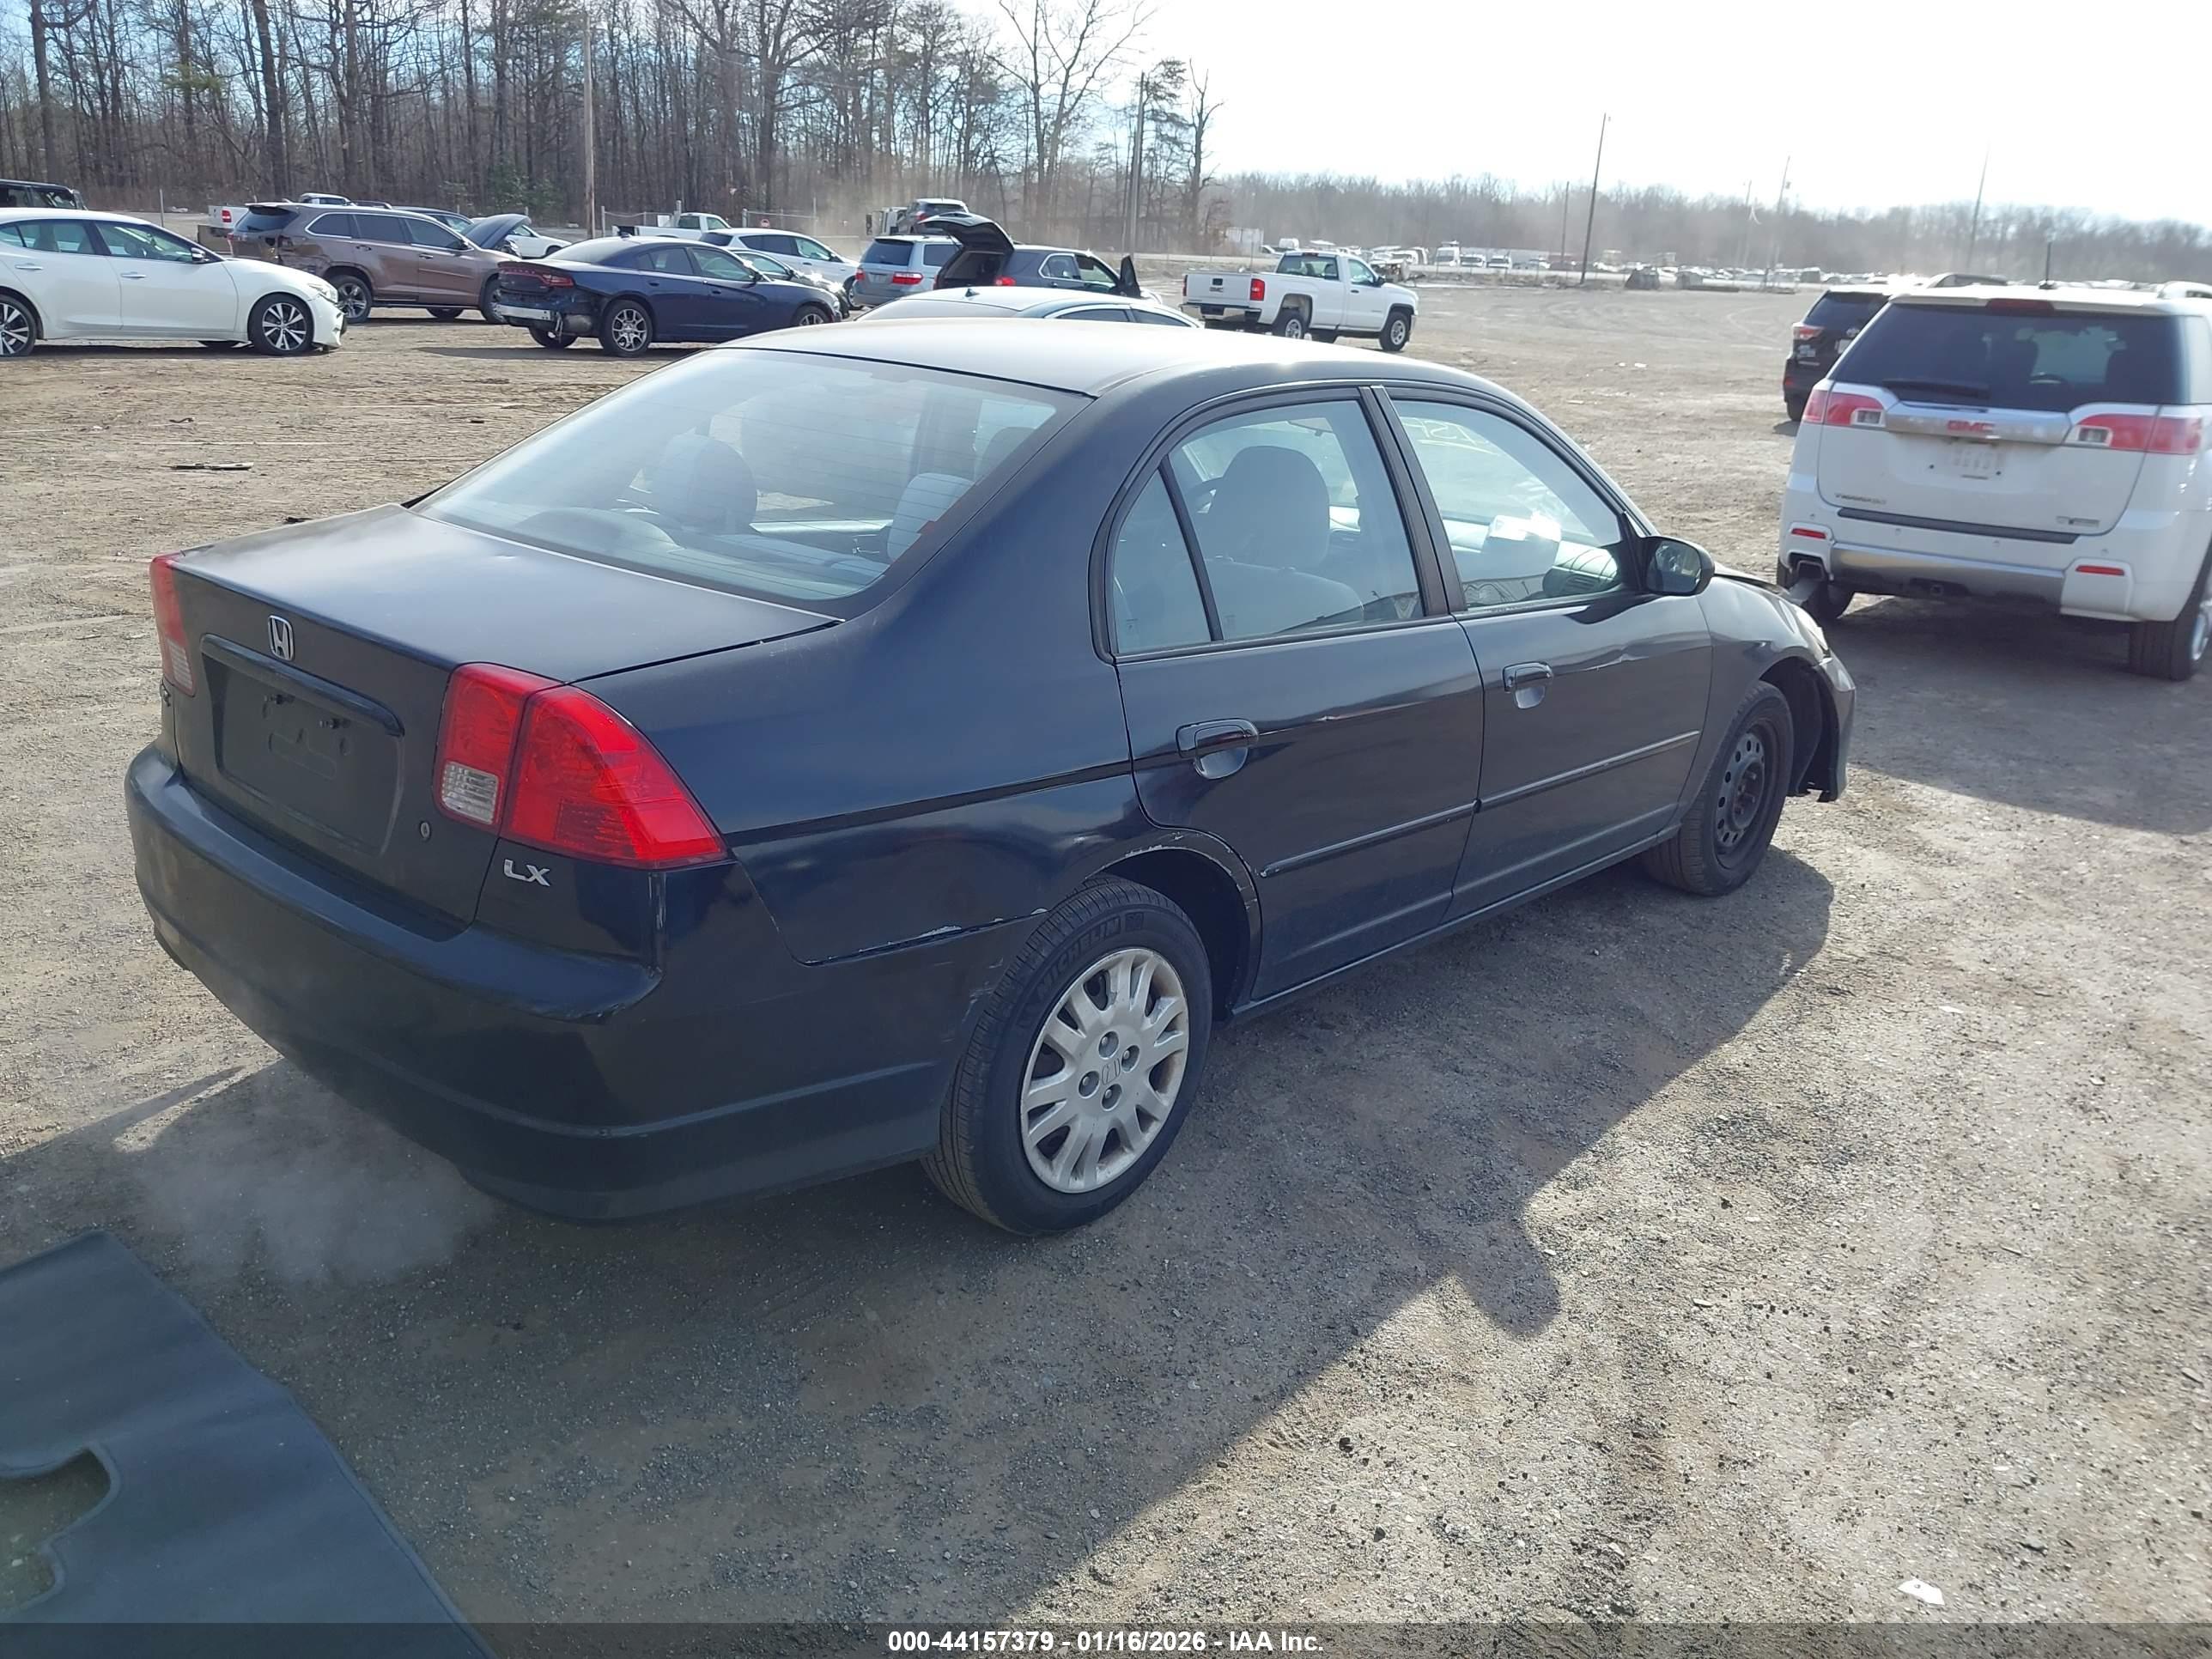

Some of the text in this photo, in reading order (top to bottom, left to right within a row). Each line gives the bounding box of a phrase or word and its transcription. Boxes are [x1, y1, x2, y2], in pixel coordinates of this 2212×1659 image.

[1947, 419, 1996, 434] GMC
[503, 859, 550, 887] LX
[1036, 915, 1121, 999] MICHELIN
